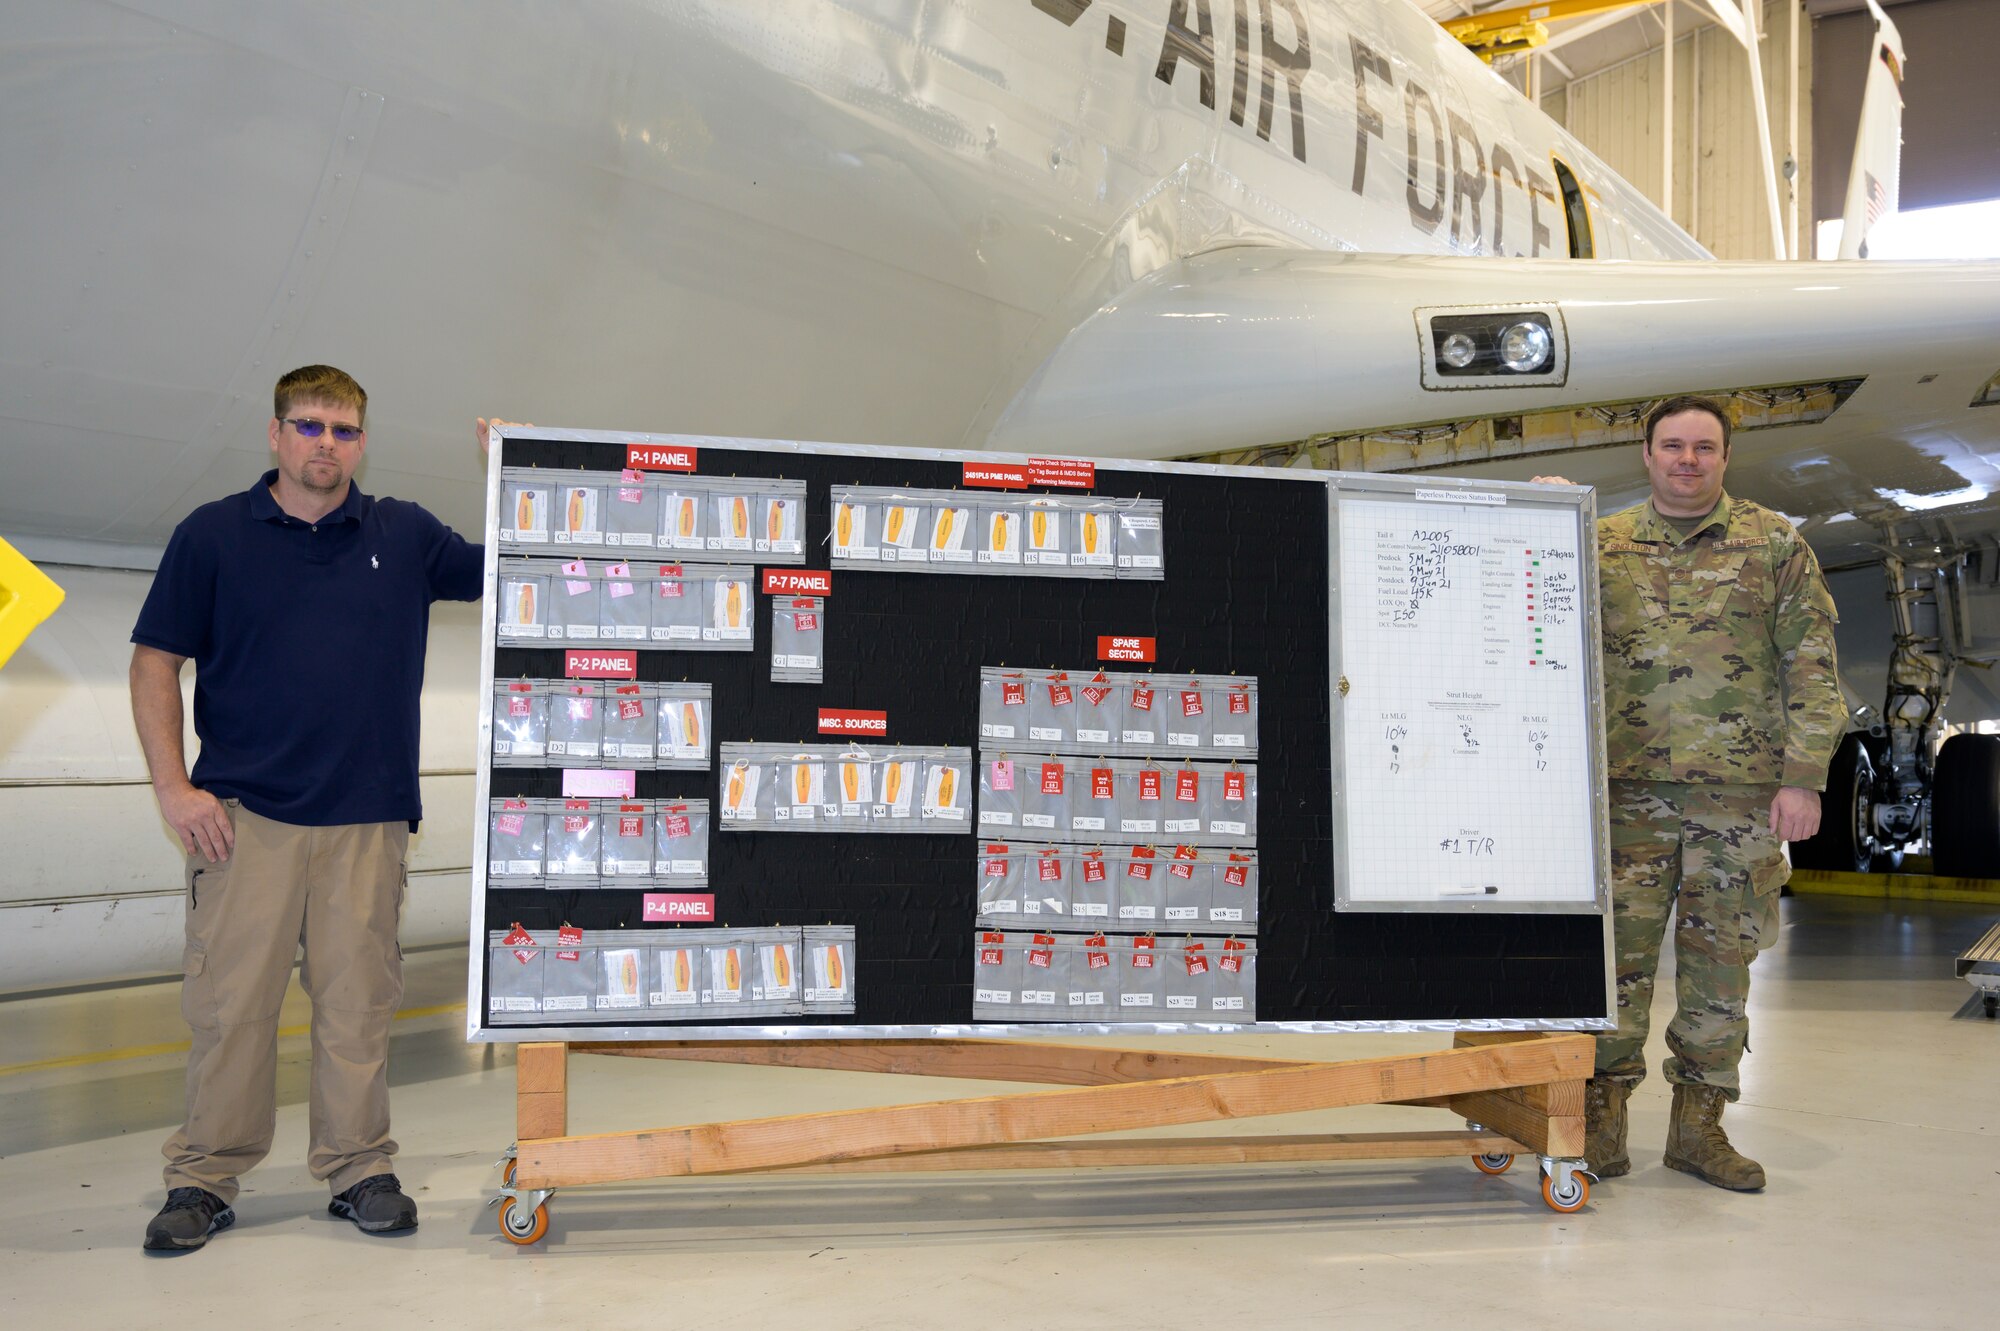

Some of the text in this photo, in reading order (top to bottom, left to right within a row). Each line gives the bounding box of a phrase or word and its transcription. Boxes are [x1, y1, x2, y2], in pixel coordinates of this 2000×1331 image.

[1155, 0, 1557, 258] AIR FORCE
[630, 452, 692, 467] P-1 PANEL
[1028, 459, 1044, 467] Always
[1060, 460, 1076, 468] System
[990, 472, 1003, 481] PME
[1003, 473, 1024, 482] PANEL
[1036, 469, 1045, 477] Tag
[1033, 478, 1086, 487] Performing Maintenance
[1416, 490, 1506, 503] Paperless Process Status Board
[501, 531, 512, 540] C1
[557, 533, 569, 542] C2
[608, 534, 619, 543] C3
[1412, 529, 1453, 543] A2005
[659, 539, 670, 547] C4
[709, 539, 720, 548] C5
[757, 541, 769, 550] C6
[1743, 538, 1766, 547] FORCE
[835, 548, 846, 556] H1
[1610, 544, 1651, 553] SINGLETON
[883, 551, 895, 559] H2
[932, 551, 943, 559] H3
[979, 552, 991, 561] H4
[1026, 554, 1037, 562] H5
[1073, 555, 1084, 563] H6
[1409, 552, 1446, 566] 5 May 21
[1119, 556, 1131, 565] H7
[1409, 564, 1446, 578] 5 May 21
[768, 575, 829, 590] P-7 PANEL
[1410, 576, 1451, 589] 9 Jun 21
[1411, 587, 1433, 599] 45K
[1394, 599, 1406, 607] Qty
[500, 625, 512, 634] C7
[549, 627, 562, 636] C8
[601, 628, 613, 637] C9
[652, 629, 669, 638] C10
[704, 630, 719, 639] C11
[1112, 638, 1140, 649] SPARE
[1108, 649, 1144, 660] SECTION
[569, 658, 632, 672] P-2 PANEL
[775, 656, 786, 665] G1
[1446, 691, 1483, 700] Strut Height
[1522, 715, 1530, 723] Rt
[819, 718, 886, 730] MISC. SOURCES
[496, 741, 508, 752] D1
[551, 743, 564, 752] D2
[660, 746, 672, 755] D4
[1390, 762, 1400, 774] 17
[1536, 759, 1547, 772] 17
[825, 806, 836, 814] K3
[1459, 828, 1480, 836] Driver
[1467, 837, 1495, 856] T/R
[493, 863, 503, 872] E1
[604, 862, 614, 872] E3
[658, 862, 669, 871] E4
[647, 902, 709, 916] P-4 PANEL
[492, 998, 502, 1008] F1
[598, 997, 609, 1006] F3
[651, 994, 662, 1003] F4
[544, 999, 556, 1008] F2
